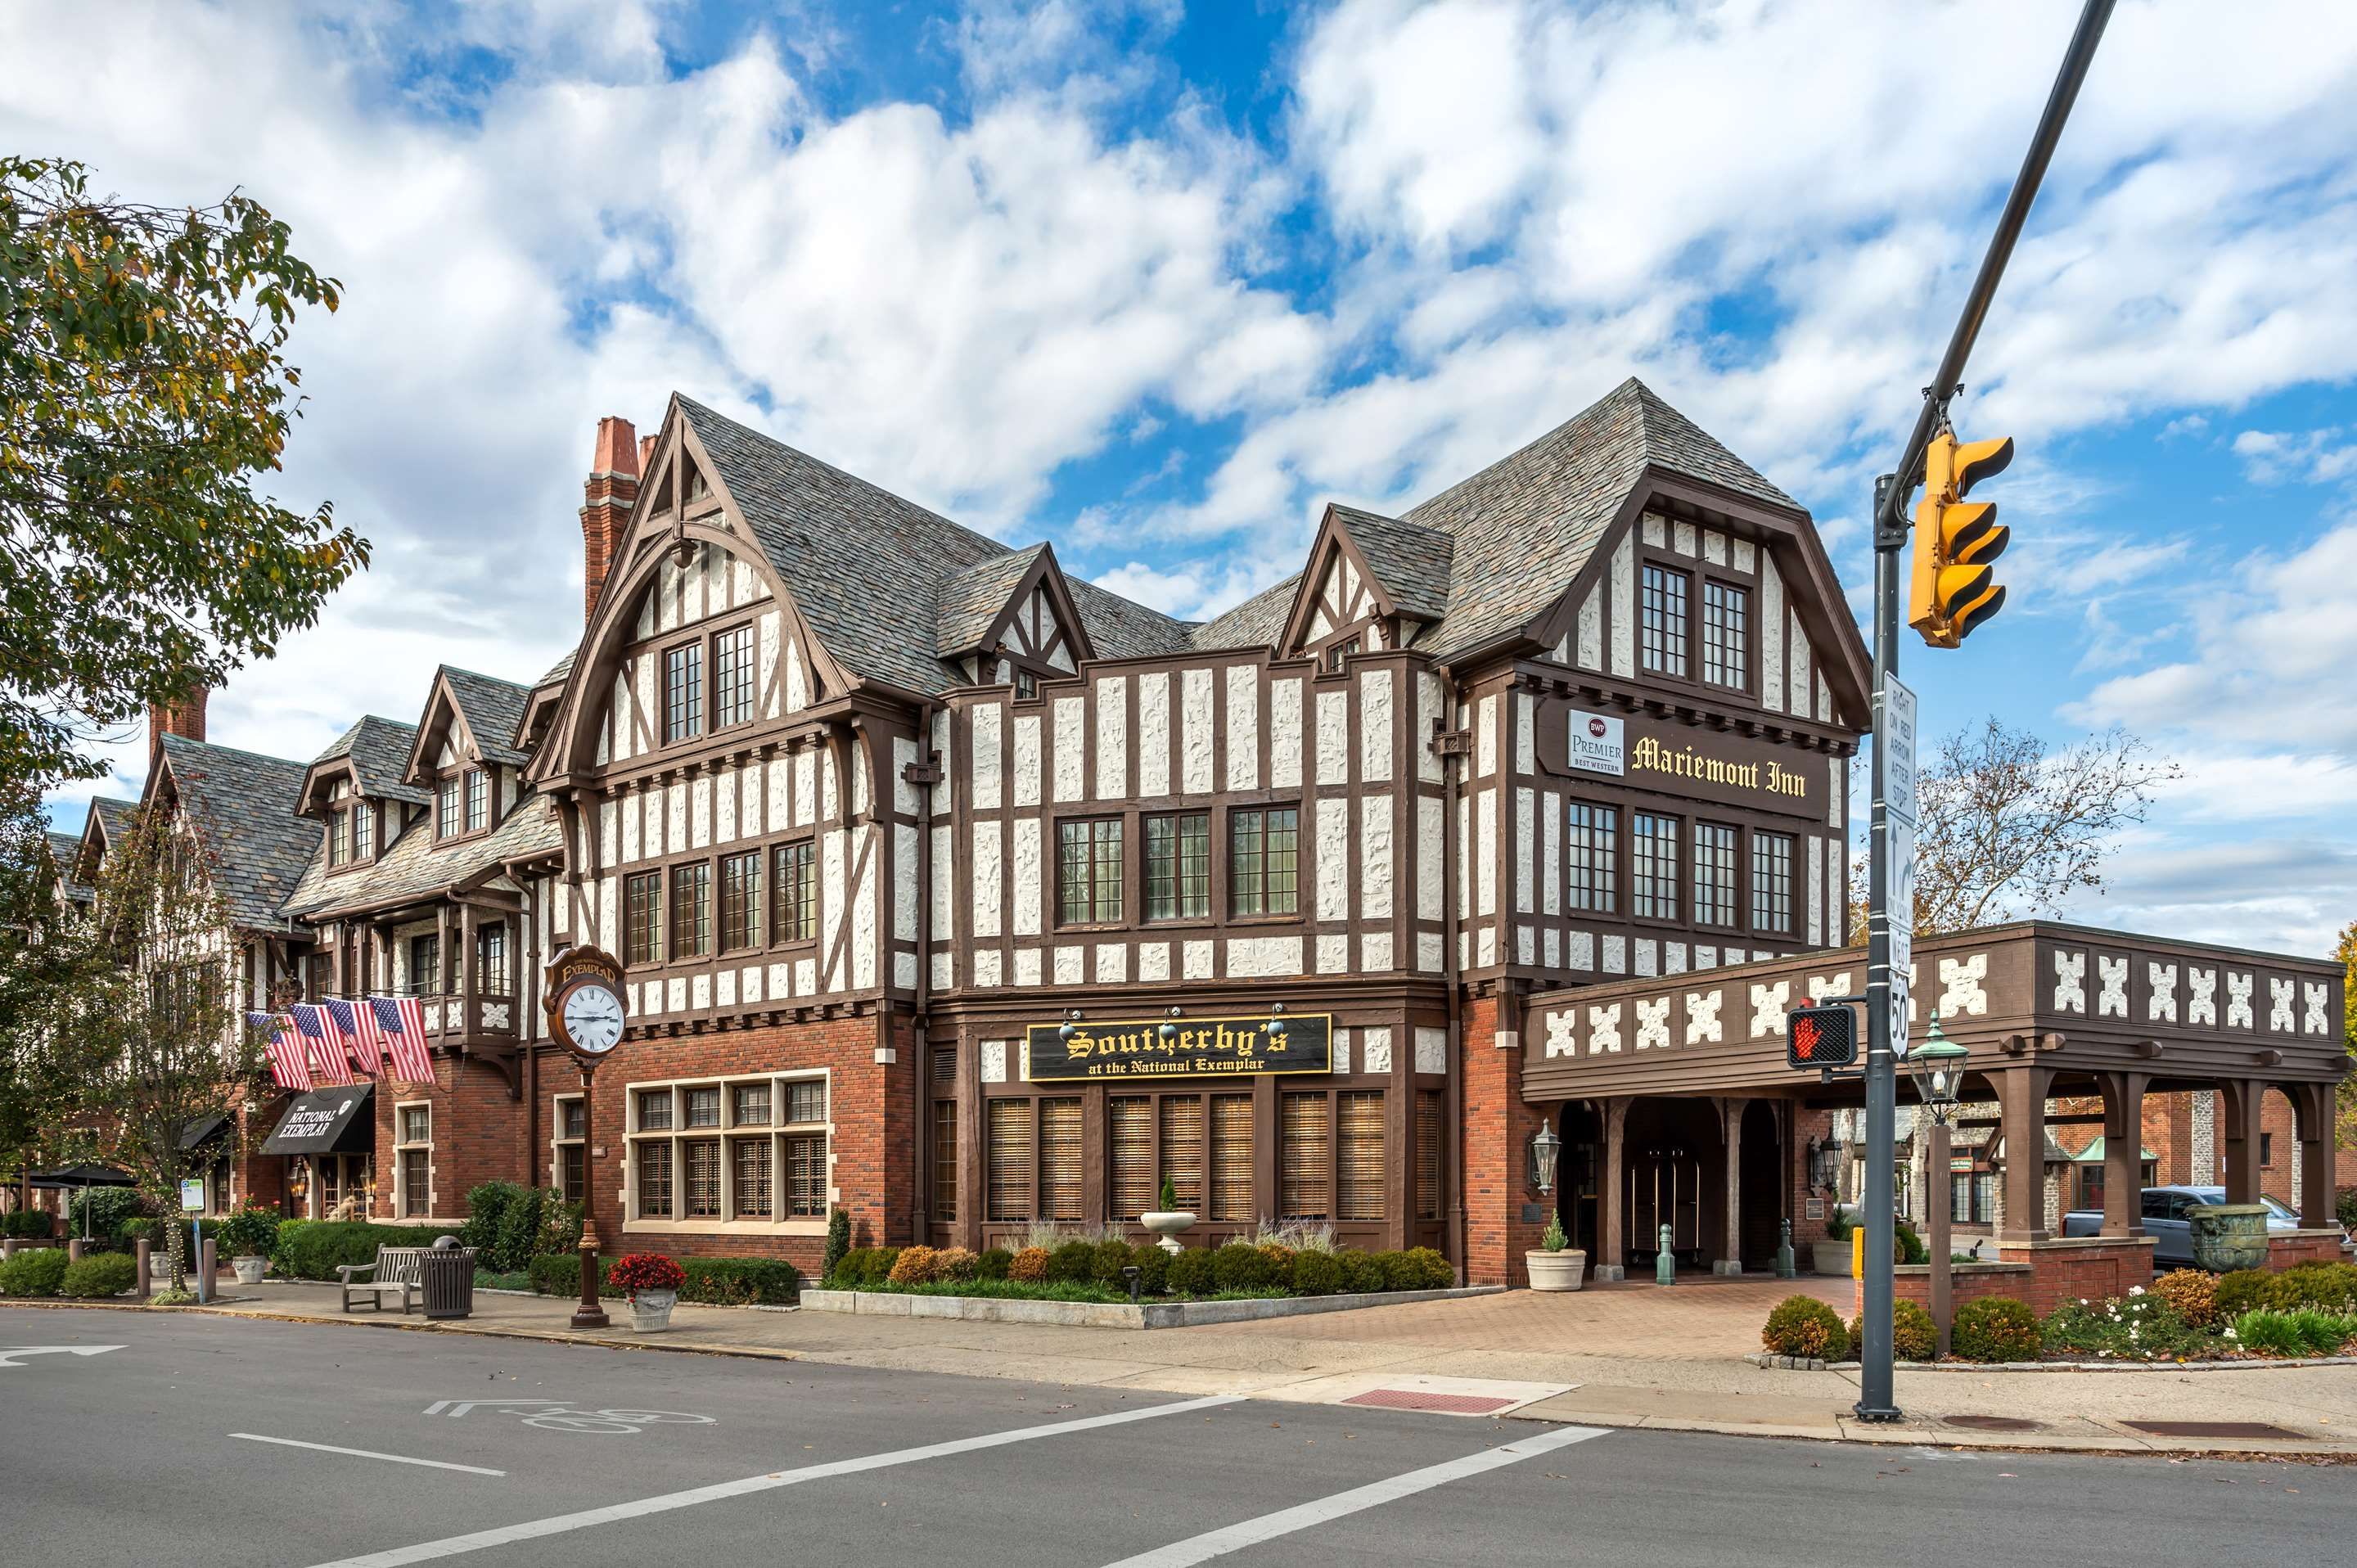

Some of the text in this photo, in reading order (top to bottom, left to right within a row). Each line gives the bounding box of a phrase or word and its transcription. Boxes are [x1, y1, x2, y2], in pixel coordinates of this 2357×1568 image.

[1893, 690, 1909, 716] RIGHT
[1590, 723, 1605, 732] BWP
[1890, 712, 1911, 740] ON RED
[1890, 737, 1909, 764] ARROW
[1575, 758, 1620, 772] BEST WESTERN
[1631, 737, 1806, 798] Mariemont Inn
[1891, 760, 1909, 786] AFTER
[1893, 785, 1908, 807] STOP
[1892, 935, 1909, 966] WEST
[562, 964, 615, 987] EXEMPLAR
[1891, 992, 1906, 1041] 50
[1088, 1057, 1265, 1075] at the National Exemplar
[288, 1110, 337, 1124] NATIONAL
[278, 1122, 330, 1138] EXEMPLAR
